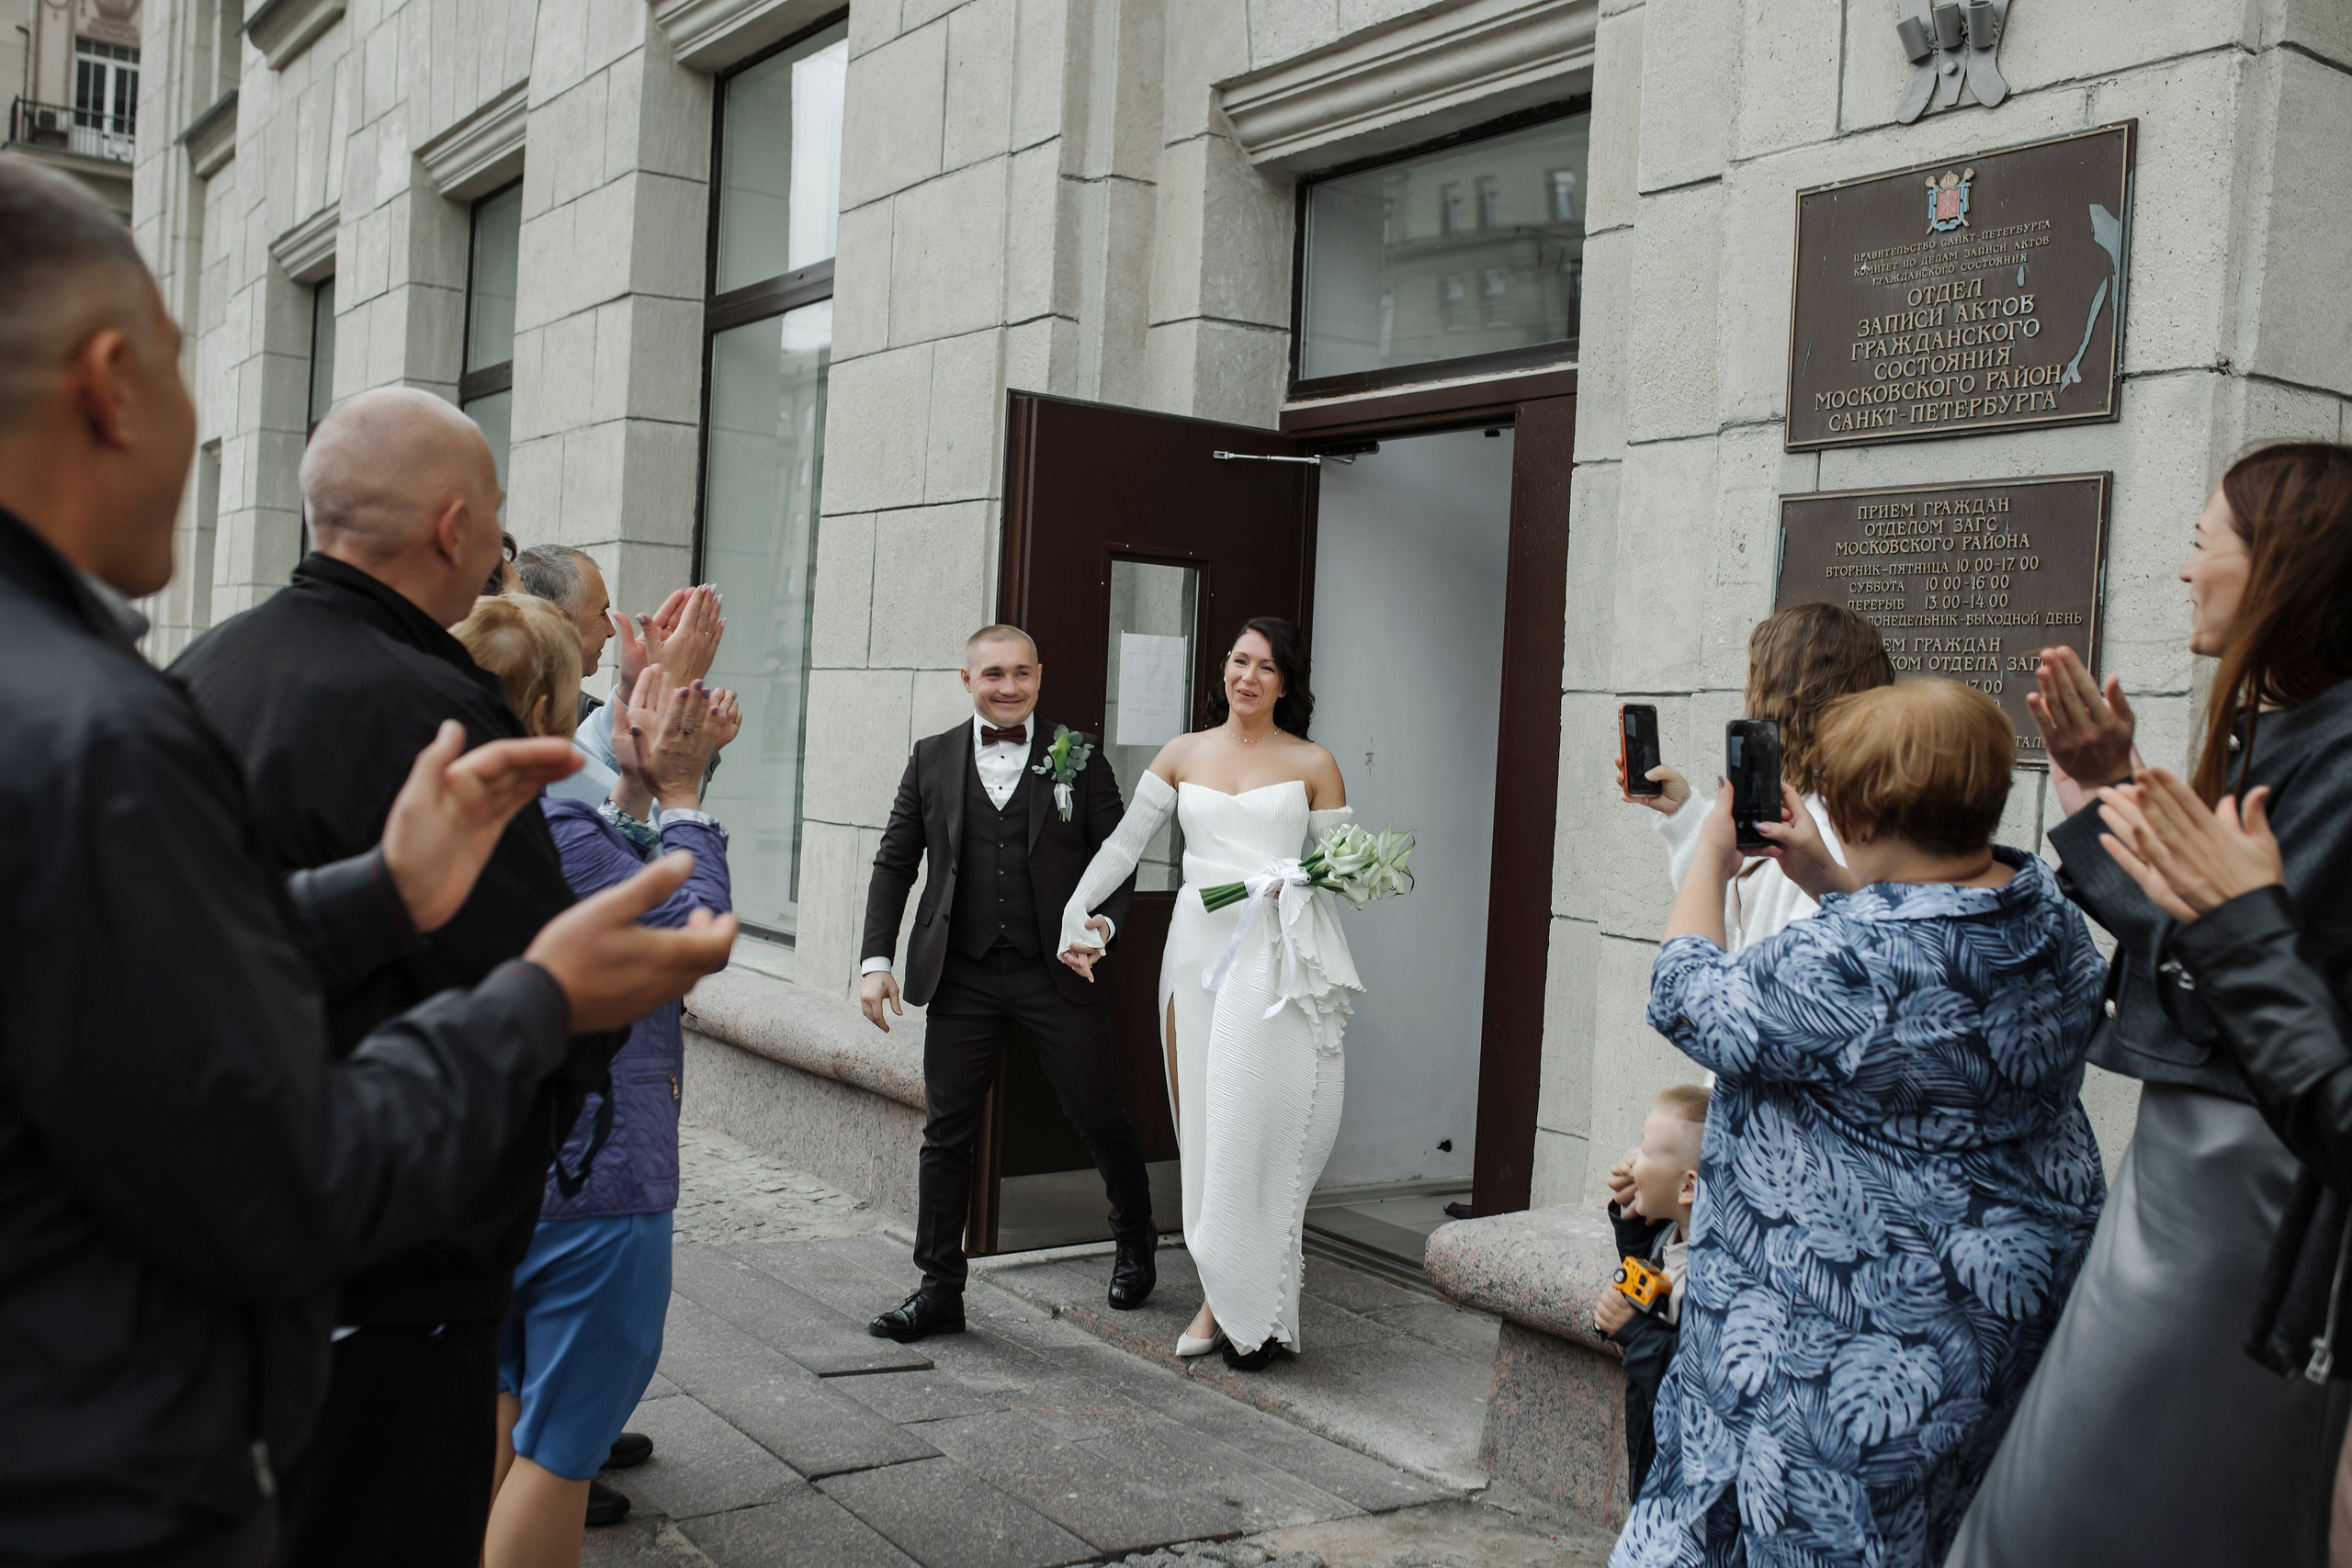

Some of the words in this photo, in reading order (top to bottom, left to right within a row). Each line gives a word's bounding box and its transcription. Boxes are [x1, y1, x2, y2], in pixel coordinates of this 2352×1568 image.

[1854, 241, 1936, 263] ПРАВИТЕЛЬСТВО
[1940, 220, 2052, 247] САНКТ-ПЕТЕРБУРГА
[1854, 262, 1898, 278] КОМИТЕТ
[1904, 259, 1917, 268] ПО
[1920, 251, 1958, 267] ДЕЛАМ
[1964, 243, 2007, 258] ЗАПИСИ
[2014, 236, 2051, 251] АКТОВ
[1872, 265, 1955, 287] ГРАЖДАНСКОГО
[1961, 253, 2028, 272] СОСТОЯНИЯ
[1907, 278, 1984, 307] ОТДЕЛ
[1858, 307, 1944, 338] ЗАПИСИ
[1955, 294, 2035, 323] АКТОВ
[1851, 318, 2041, 361] ГРАЖДАНСКОГО
[1874, 346, 2012, 380] СОСТОЯНИЯ
[1815, 375, 1975, 412] МОСКОВСКОГО
[1828, 389, 2058, 432] САНКТ-ПЕТЕРБУРГА
[1858, 502, 1915, 520] ПРИЕМ
[1923, 497, 2010, 516] ГРАЖДАН
[1865, 519, 1944, 539] ОТДЕЛОМ
[1953, 517, 1998, 533] ЗАГС
[1836, 536, 1954, 556] МОСКОВСКОГО
[1962, 532, 2030, 551] РАЙОНА
[1849, 581, 1905, 593] СУББОТА
[1848, 598, 1905, 611] ПЕРЕРЫВ
[2044, 612, 2083, 626] ДЕНЬ
[1914, 637, 2002, 654] ГРАЖДАН
[1928, 656, 1999, 673] ОТДЕЛА
